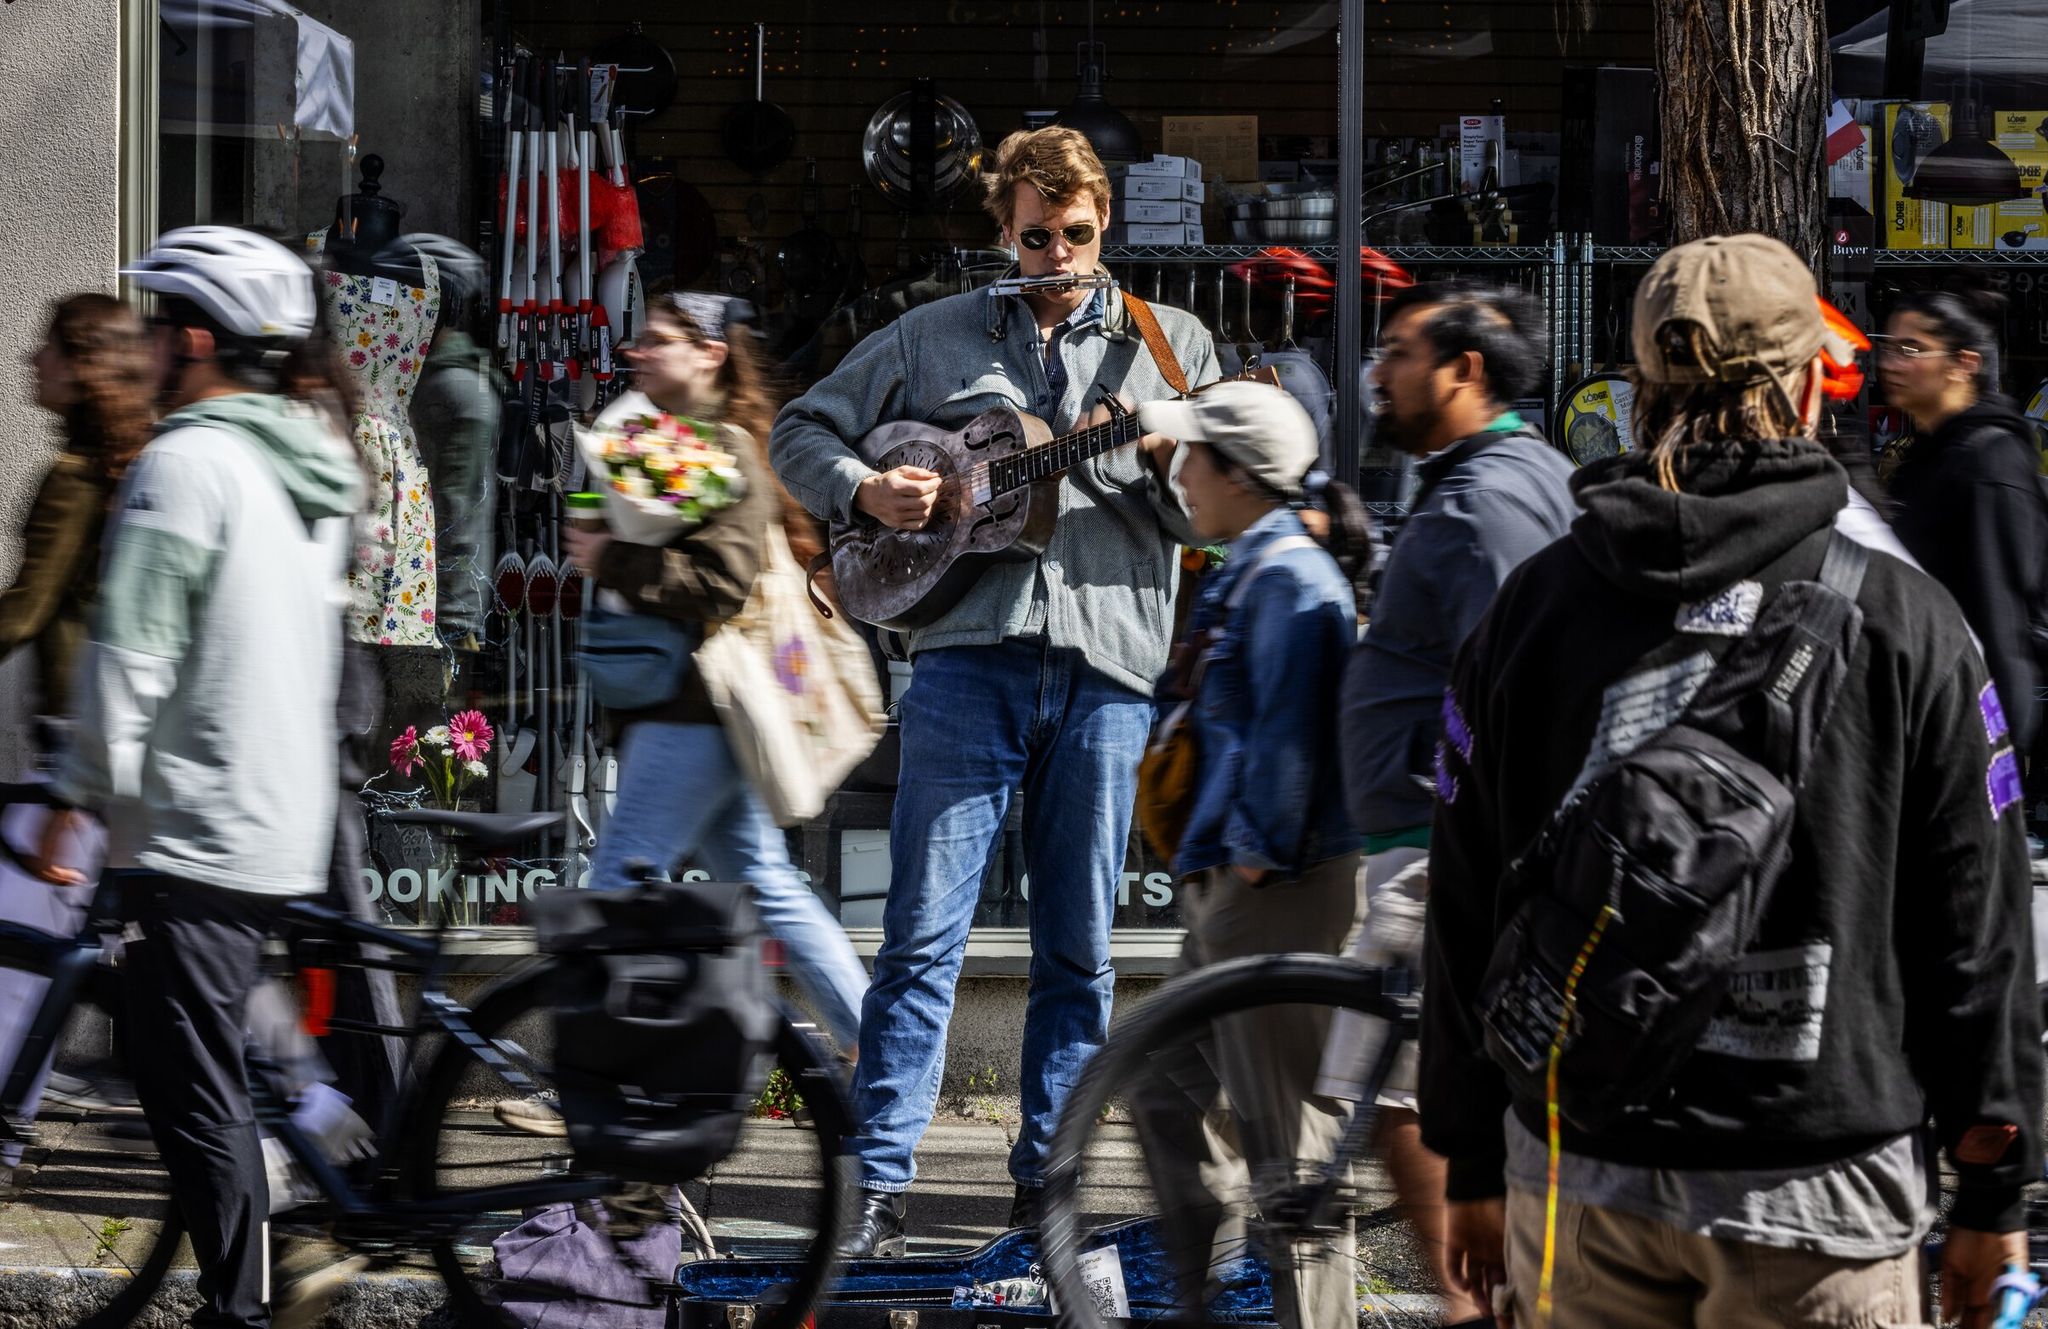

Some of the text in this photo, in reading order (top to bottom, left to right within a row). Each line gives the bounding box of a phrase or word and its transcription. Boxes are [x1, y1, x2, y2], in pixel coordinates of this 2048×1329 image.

[1895, 201, 1904, 231] LODGE
[1833, 244, 1869, 258] Buyer
[356, 867, 557, 903] OOKING
